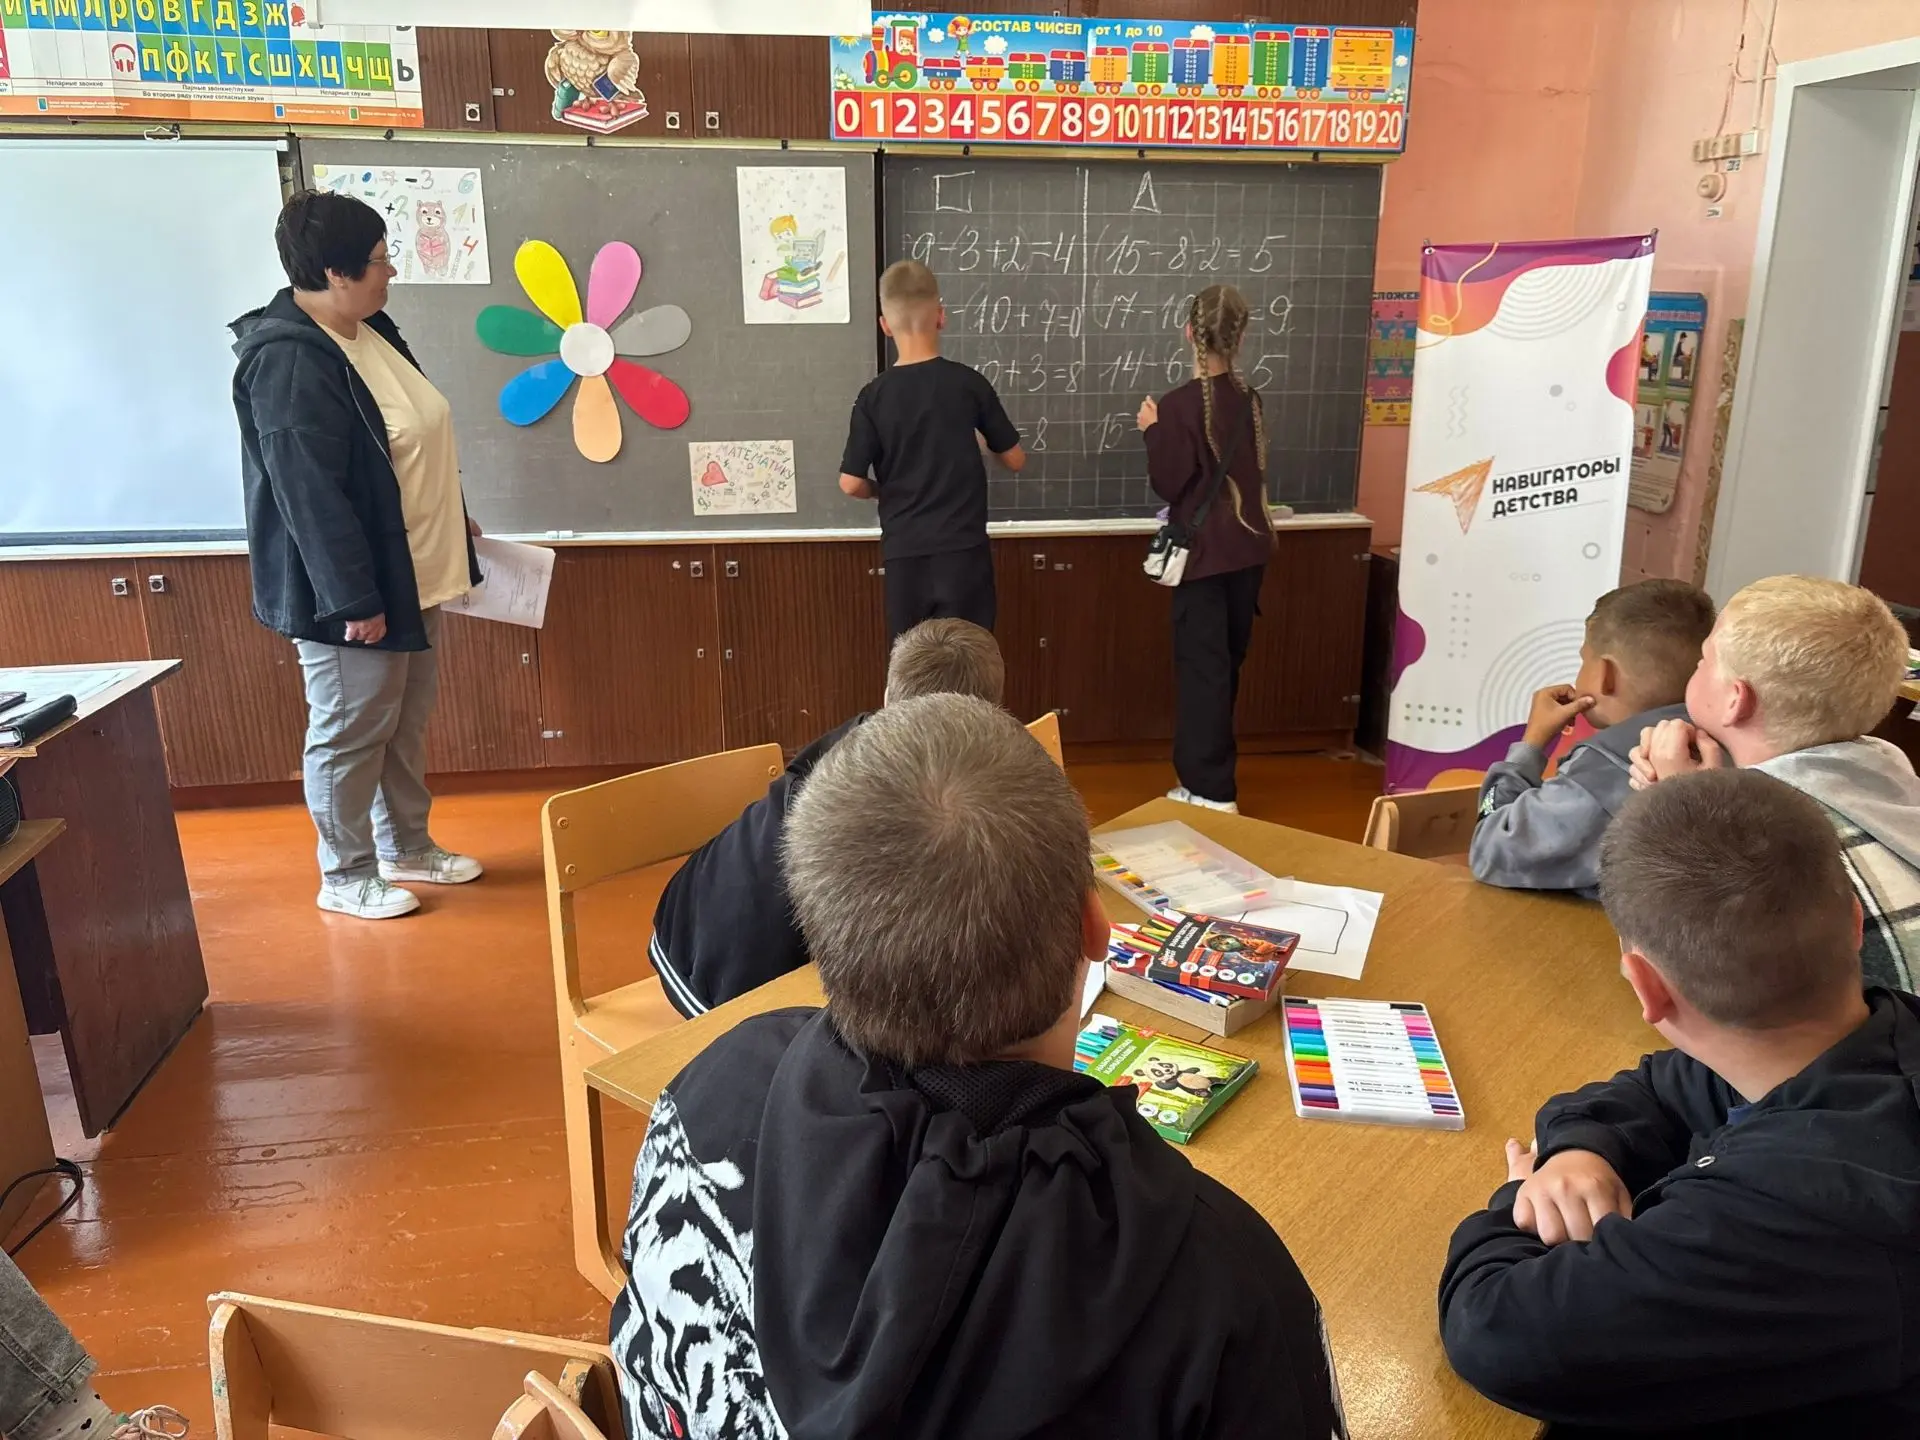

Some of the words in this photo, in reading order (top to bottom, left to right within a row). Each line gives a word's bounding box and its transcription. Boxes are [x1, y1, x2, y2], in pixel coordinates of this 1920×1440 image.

[972, 20, 1031, 33] СОСТАВ
[1035, 22, 1082, 35] ЧИСЕЛ
[1095, 26, 1110, 35] от
[1114, 24, 1121, 35] 1
[1125, 26, 1142, 38] до
[1146, 25, 1163, 37] 10
[838, 98, 861, 132] 0
[869, 98, 885, 133] 1
[895, 98, 917, 133] 2
[923, 98, 945, 134] 3
[950, 100, 975, 134] 4
[980, 100, 1002, 134] 5
[1007, 100, 1031, 135] 6
[1036, 102, 1057, 136] 7
[1061, 102, 1083, 137] 8
[1088, 103, 1111, 137] 9
[1114, 104, 1140, 138] 10
[1142, 105, 1166, 139] 11
[1168, 105, 1194, 139] 12
[1195, 105, 1221, 140] 13
[1222, 106, 1247, 140] 14
[1249, 107, 1273, 141] 15
[1275, 107, 1300, 141] 16
[1301, 108, 1327, 142] 17
[1327, 108, 1351, 142] 18
[1353, 109, 1377, 143] 19
[1376, 109, 1403, 143] 20
[388, 239, 403, 258] 5
[463, 235, 479, 257] 4
[1492, 457, 1621, 494] НАВИГАТОРЫ
[1492, 488, 1579, 518] ДЕТСТВА
